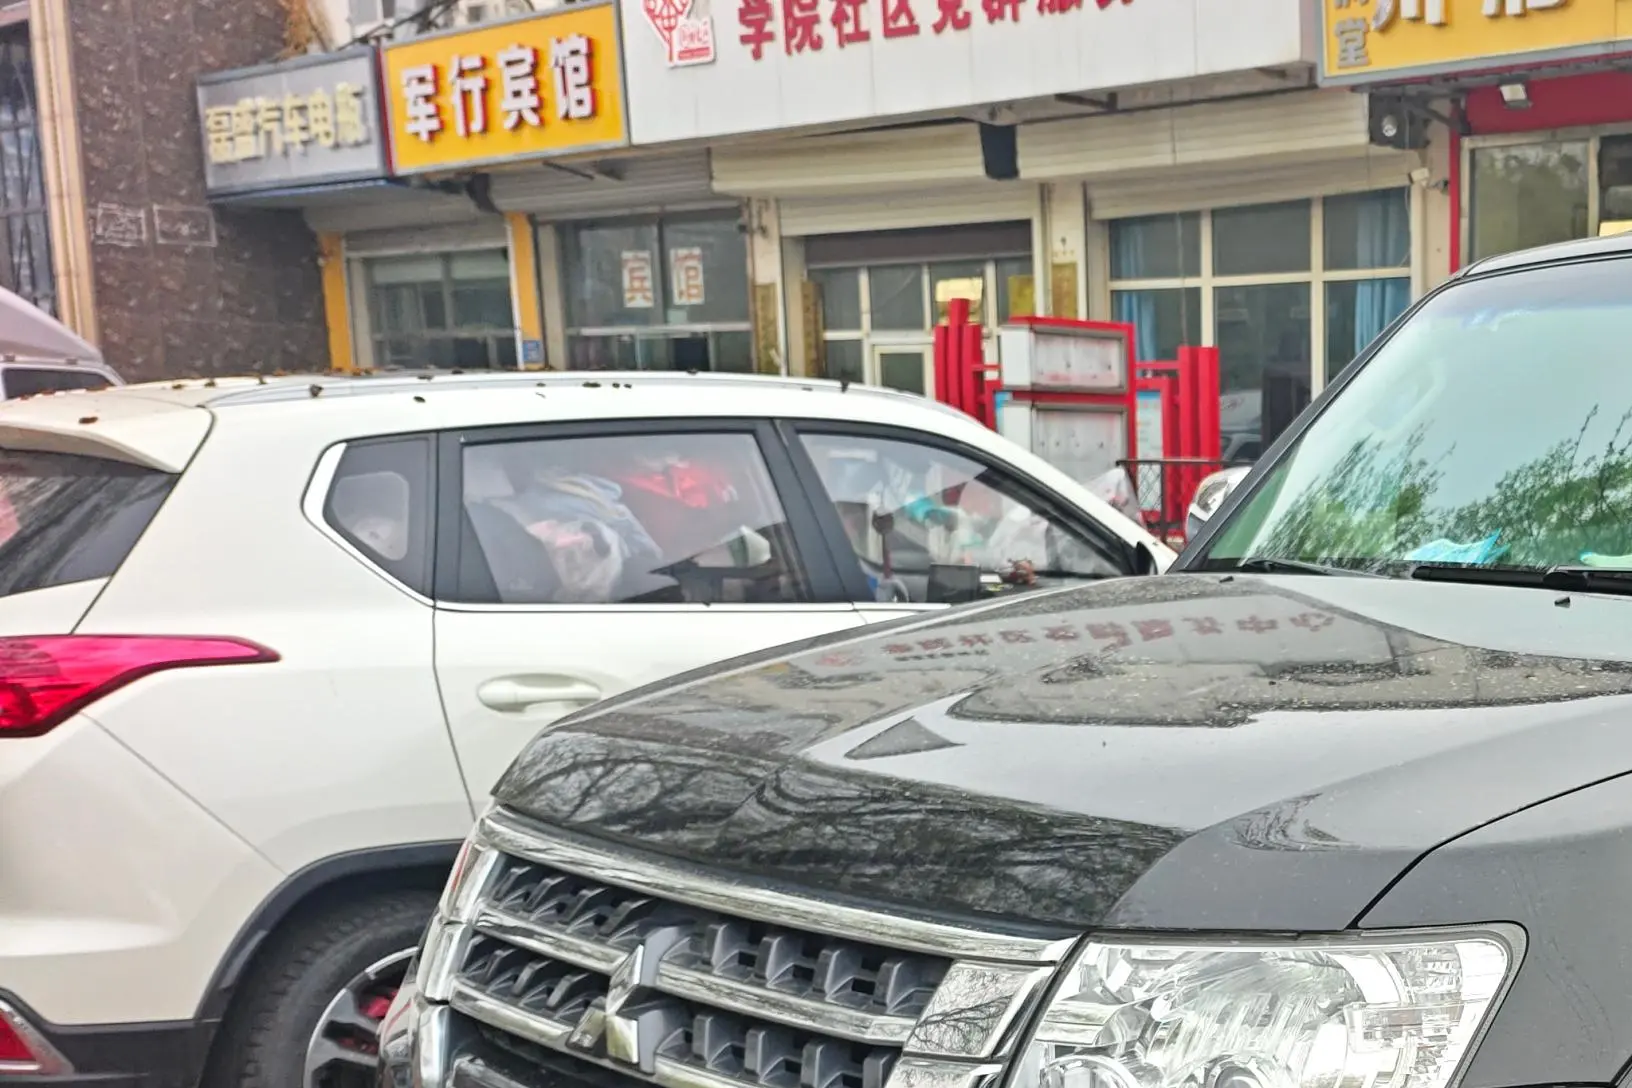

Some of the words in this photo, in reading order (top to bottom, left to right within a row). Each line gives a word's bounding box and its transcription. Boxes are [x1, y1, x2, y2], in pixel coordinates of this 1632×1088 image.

[736, 0, 1135, 61] 学院社区
[402, 33, 596, 142] 军行宾馆
